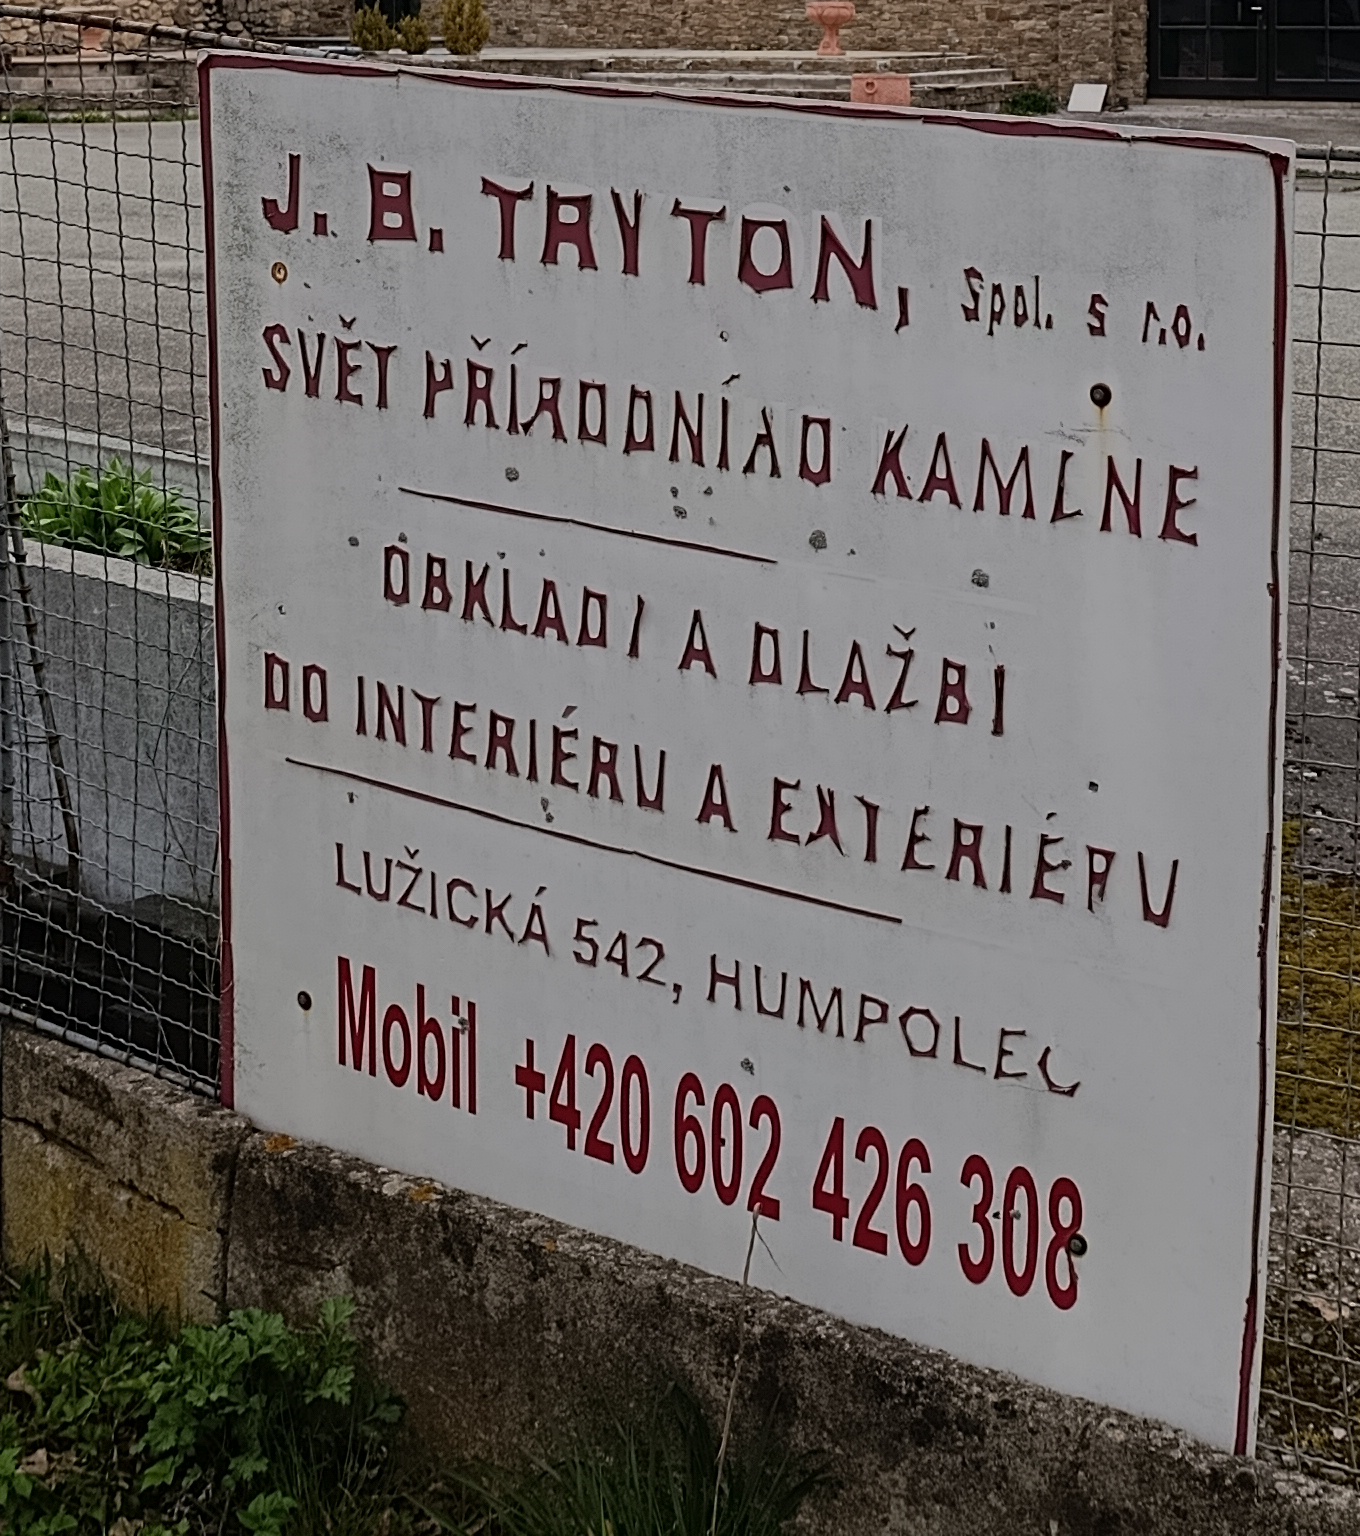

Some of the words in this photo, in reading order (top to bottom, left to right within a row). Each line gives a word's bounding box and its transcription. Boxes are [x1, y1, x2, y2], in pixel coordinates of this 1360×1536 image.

[261, 152, 329, 237] J.
[366, 162, 444, 254] B.
[261, 314, 398, 410] SVĚT
[677, 608, 717, 680] A
[263, 651, 329, 723] DO
[355, 674, 667, 814] INTERIÉRU
[695, 764, 738, 833] A
[334, 841, 551, 958] LUŽICKÁ
[572, 916, 683, 1004] 542,
[337, 954, 478, 1116] Mobil
[513, 1032, 651, 1175] +420
[673, 1071, 782, 1222] 602
[811, 1116, 933, 1267] 426
[955, 1154, 1085, 1311] 308
